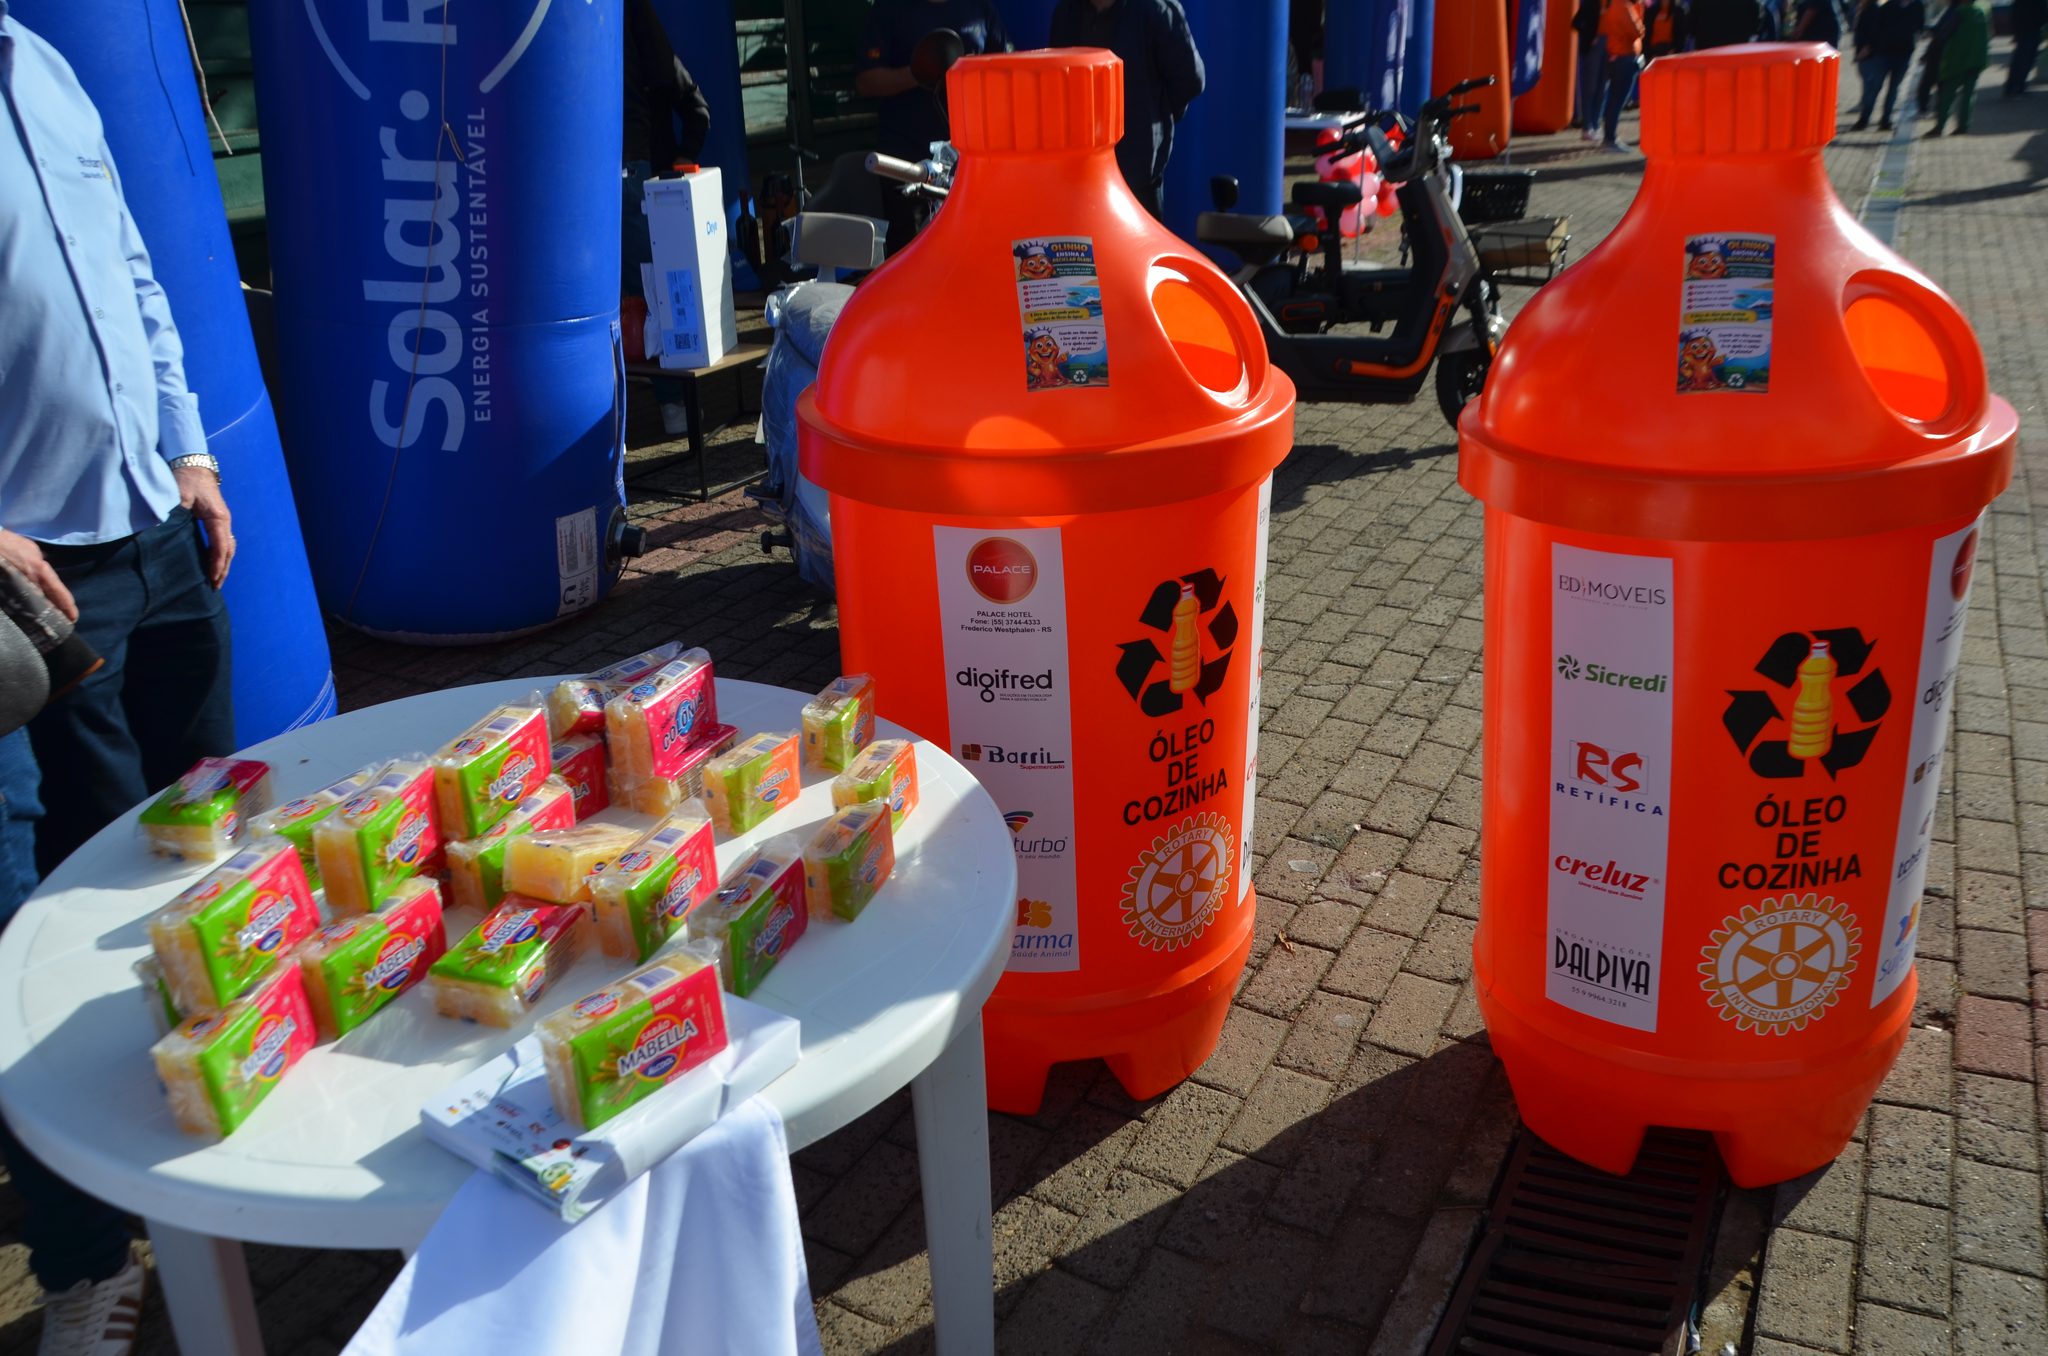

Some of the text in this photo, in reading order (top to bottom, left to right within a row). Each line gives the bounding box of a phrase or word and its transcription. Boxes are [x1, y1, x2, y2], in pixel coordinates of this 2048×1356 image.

[464, 107, 491, 422] ENERGIA SUSTENTÁVEL
[1051, 243, 1088, 252] OLINHO
[973, 565, 1031, 574] PALACE
[961, 624, 993, 633] Frederico
[995, 626, 1035, 635] Westphalen
[956, 667, 1053, 703] digifred
[1585, 663, 1667, 693] Sicredi
[1149, 718, 1215, 762] ÓLEO
[489, 755, 536, 801] MABELLA
[1168, 753, 1198, 787] DE
[1577, 741, 1643, 792] RS
[1123, 768, 1227, 826] COZINHA
[1555, 782, 1663, 816] RETÍFICA
[1755, 793, 1847, 828] ÓLEO
[1013, 837, 1065, 853] turbo
[1163, 829, 1210, 857] ROTARY
[1776, 830, 1821, 859] DE
[1554, 854, 1650, 893] creluz
[1718, 854, 1861, 890] COZINHA
[656, 866, 702, 918] MABELLA
[1145, 883, 1222, 938] INTERNATIONAL
[1755, 911, 1823, 931] ROTARY
[1011, 949, 1071, 958] Saúde Animal
[1556, 928, 1651, 958] ORGANIZAÇÕES
[364, 936, 426, 991] MABELLA
[1555, 935, 1650, 995] DALPIVA
[1571, 986, 1580, 994] 55
[1728, 971, 1838, 1022] INTERNATIONAL
[618, 1017, 698, 1077] MABELLA
